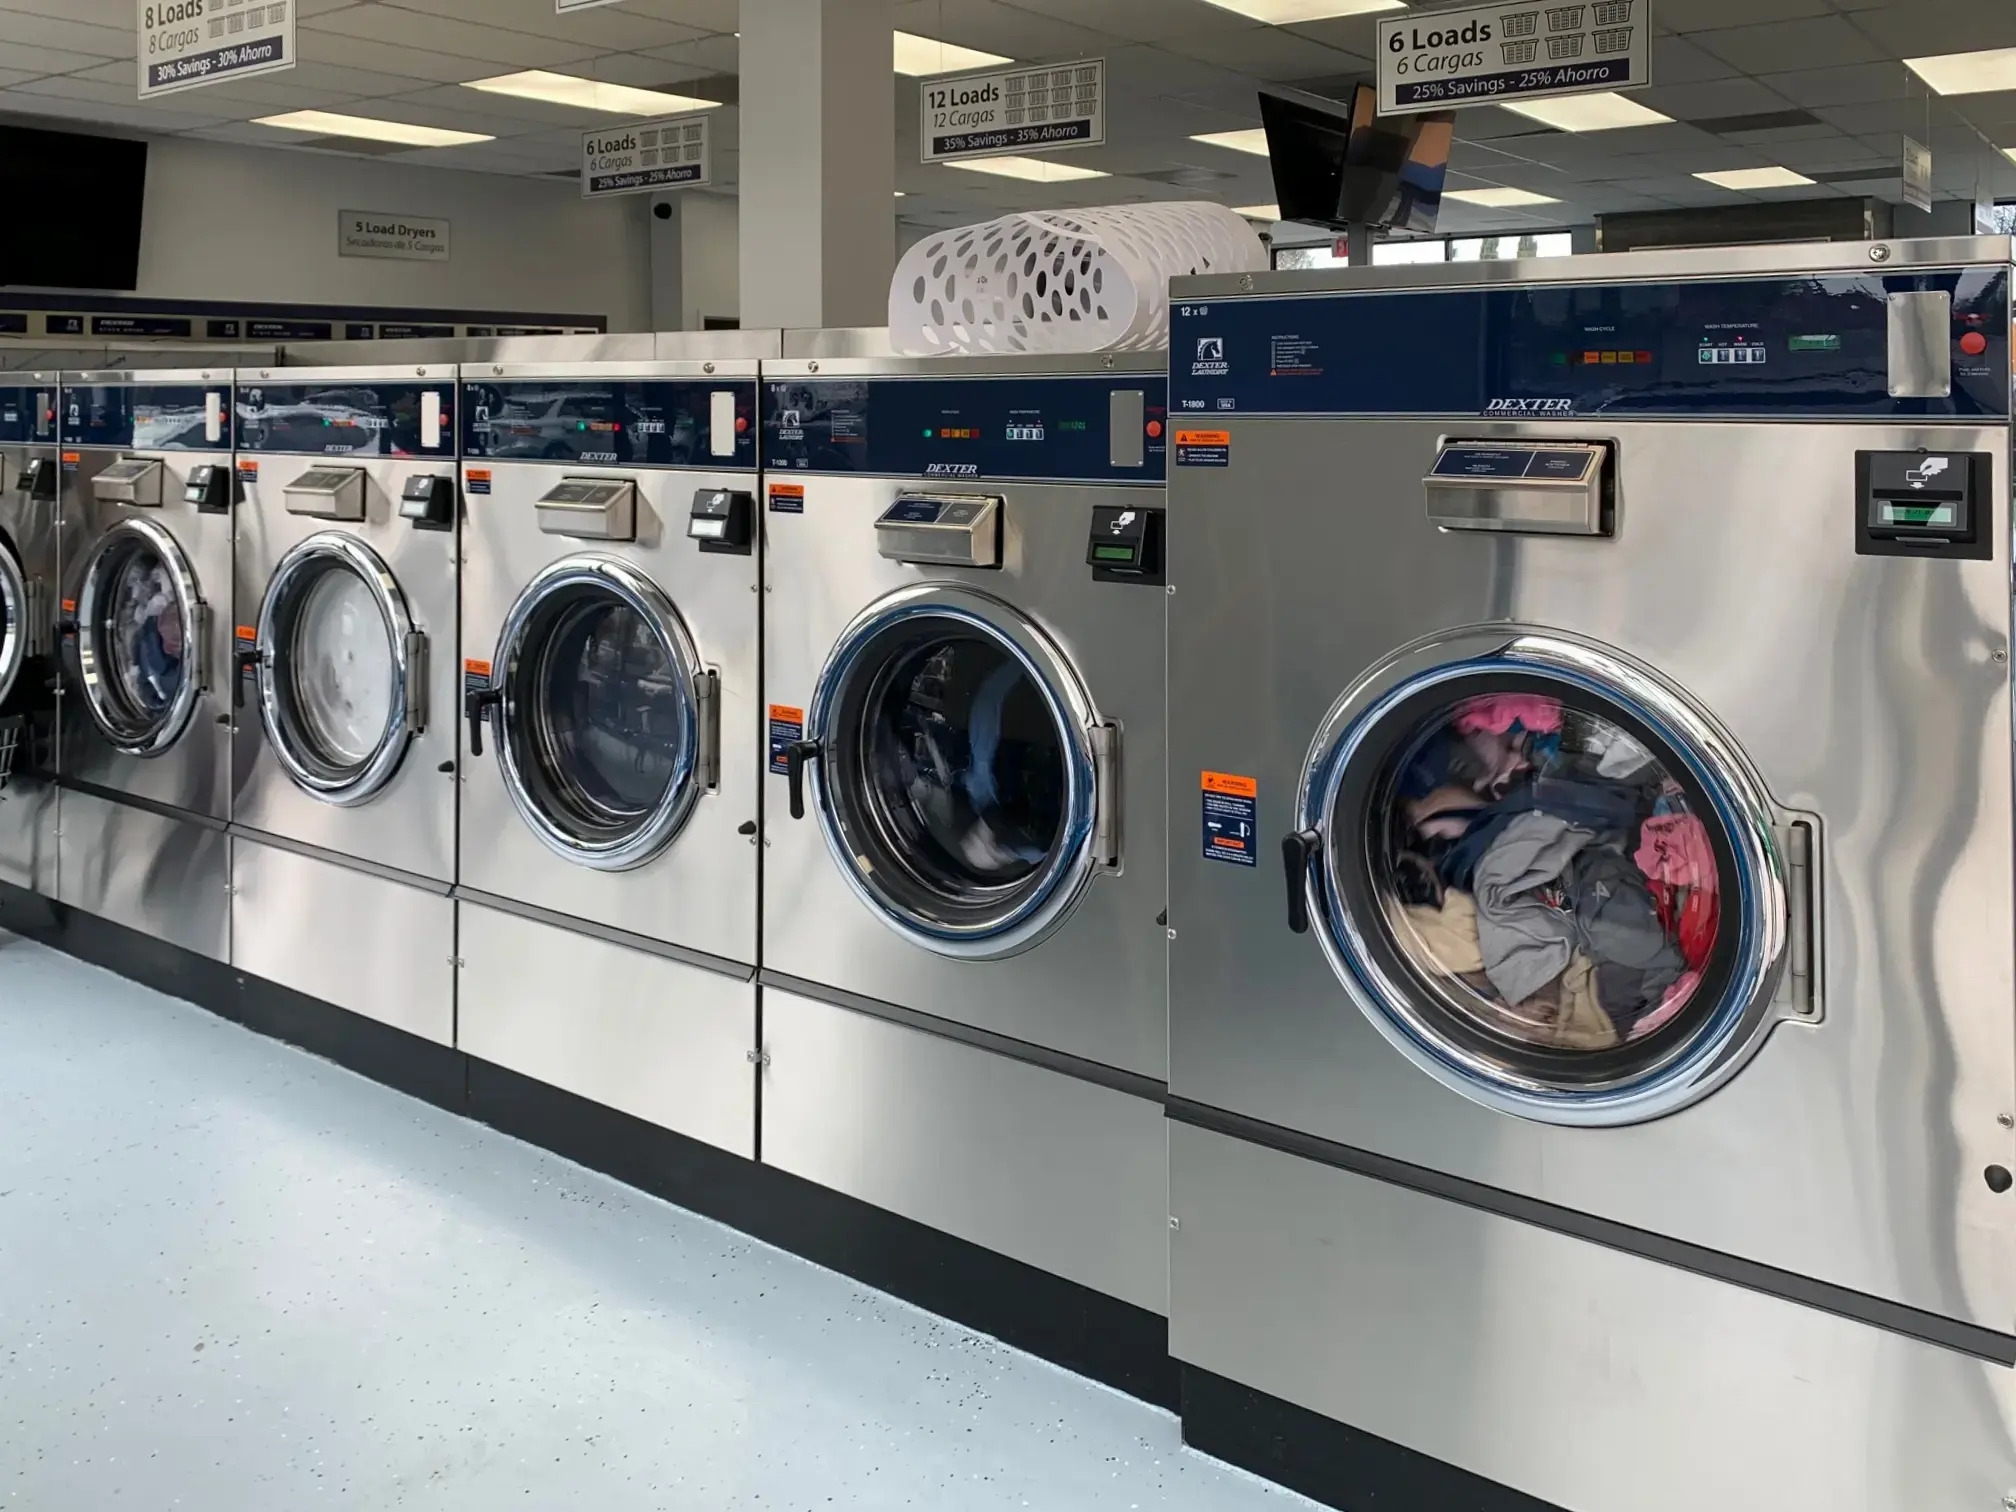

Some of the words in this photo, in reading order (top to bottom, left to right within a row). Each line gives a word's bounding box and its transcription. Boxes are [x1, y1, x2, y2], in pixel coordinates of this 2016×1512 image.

[145, 7, 154, 29] 8
[158, 0, 203, 27] Loads
[149, 34, 156, 55] 8
[158, 27, 200, 52] Cargas
[1389, 31, 1405, 52] 6
[1412, 20, 1492, 50] Loads
[157, 64, 176, 81] 30%
[177, 57, 211, 76] Savings
[217, 50, 238, 68] 30%
[238, 44, 273, 63] Ahorro
[1396, 56, 1408, 75] 6
[1414, 51, 1483, 74] Cargas
[1412, 84, 1444, 99] 25%
[1447, 77, 1505, 96] Savings
[1518, 72, 1551, 88] 25%
[1554, 66, 1610, 84] Ahorro
[928, 91, 947, 109] 12
[950, 83, 1000, 106] Loads
[933, 112, 946, 128] 12
[949, 109, 995, 128] Cargas
[586, 140, 595, 156] 6
[597, 133, 637, 154] Loads
[943, 137, 966, 151] 35%
[967, 131, 1008, 148] Savings
[1016, 128, 1039, 142] 35%
[1040, 124, 1078, 141] Ahorro
[590, 157, 597, 171] 6
[598, 155, 633, 171] Cargas
[665, 168, 693, 180] Ahorro
[355, 221, 363, 232] 5
[366, 222, 395, 235] Load
[398, 224, 436, 239] Dryers
[1180, 307, 1191, 316] 12
[1486, 398, 1573, 410] DEXTER
[580, 452, 618, 460] DEXTER
[926, 463, 978, 473] DEXTER
